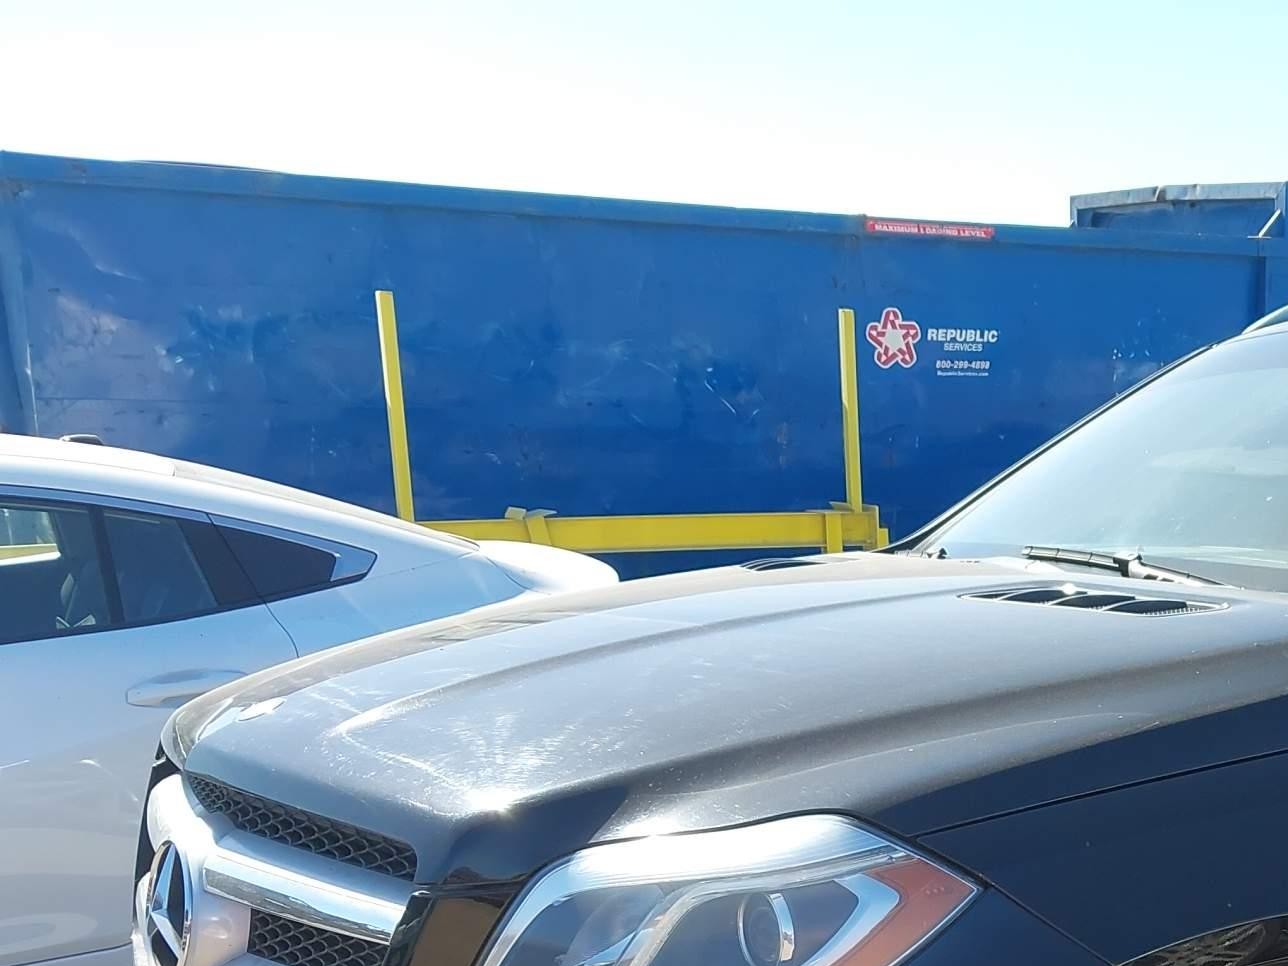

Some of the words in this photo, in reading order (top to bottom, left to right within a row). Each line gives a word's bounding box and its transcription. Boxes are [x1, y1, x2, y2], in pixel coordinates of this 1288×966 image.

[875, 223, 918, 234] MAXIMUM
[960, 228, 986, 238] LEVEL
[927, 328, 999, 343] REPUBLIC
[944, 343, 983, 352] SERVICES
